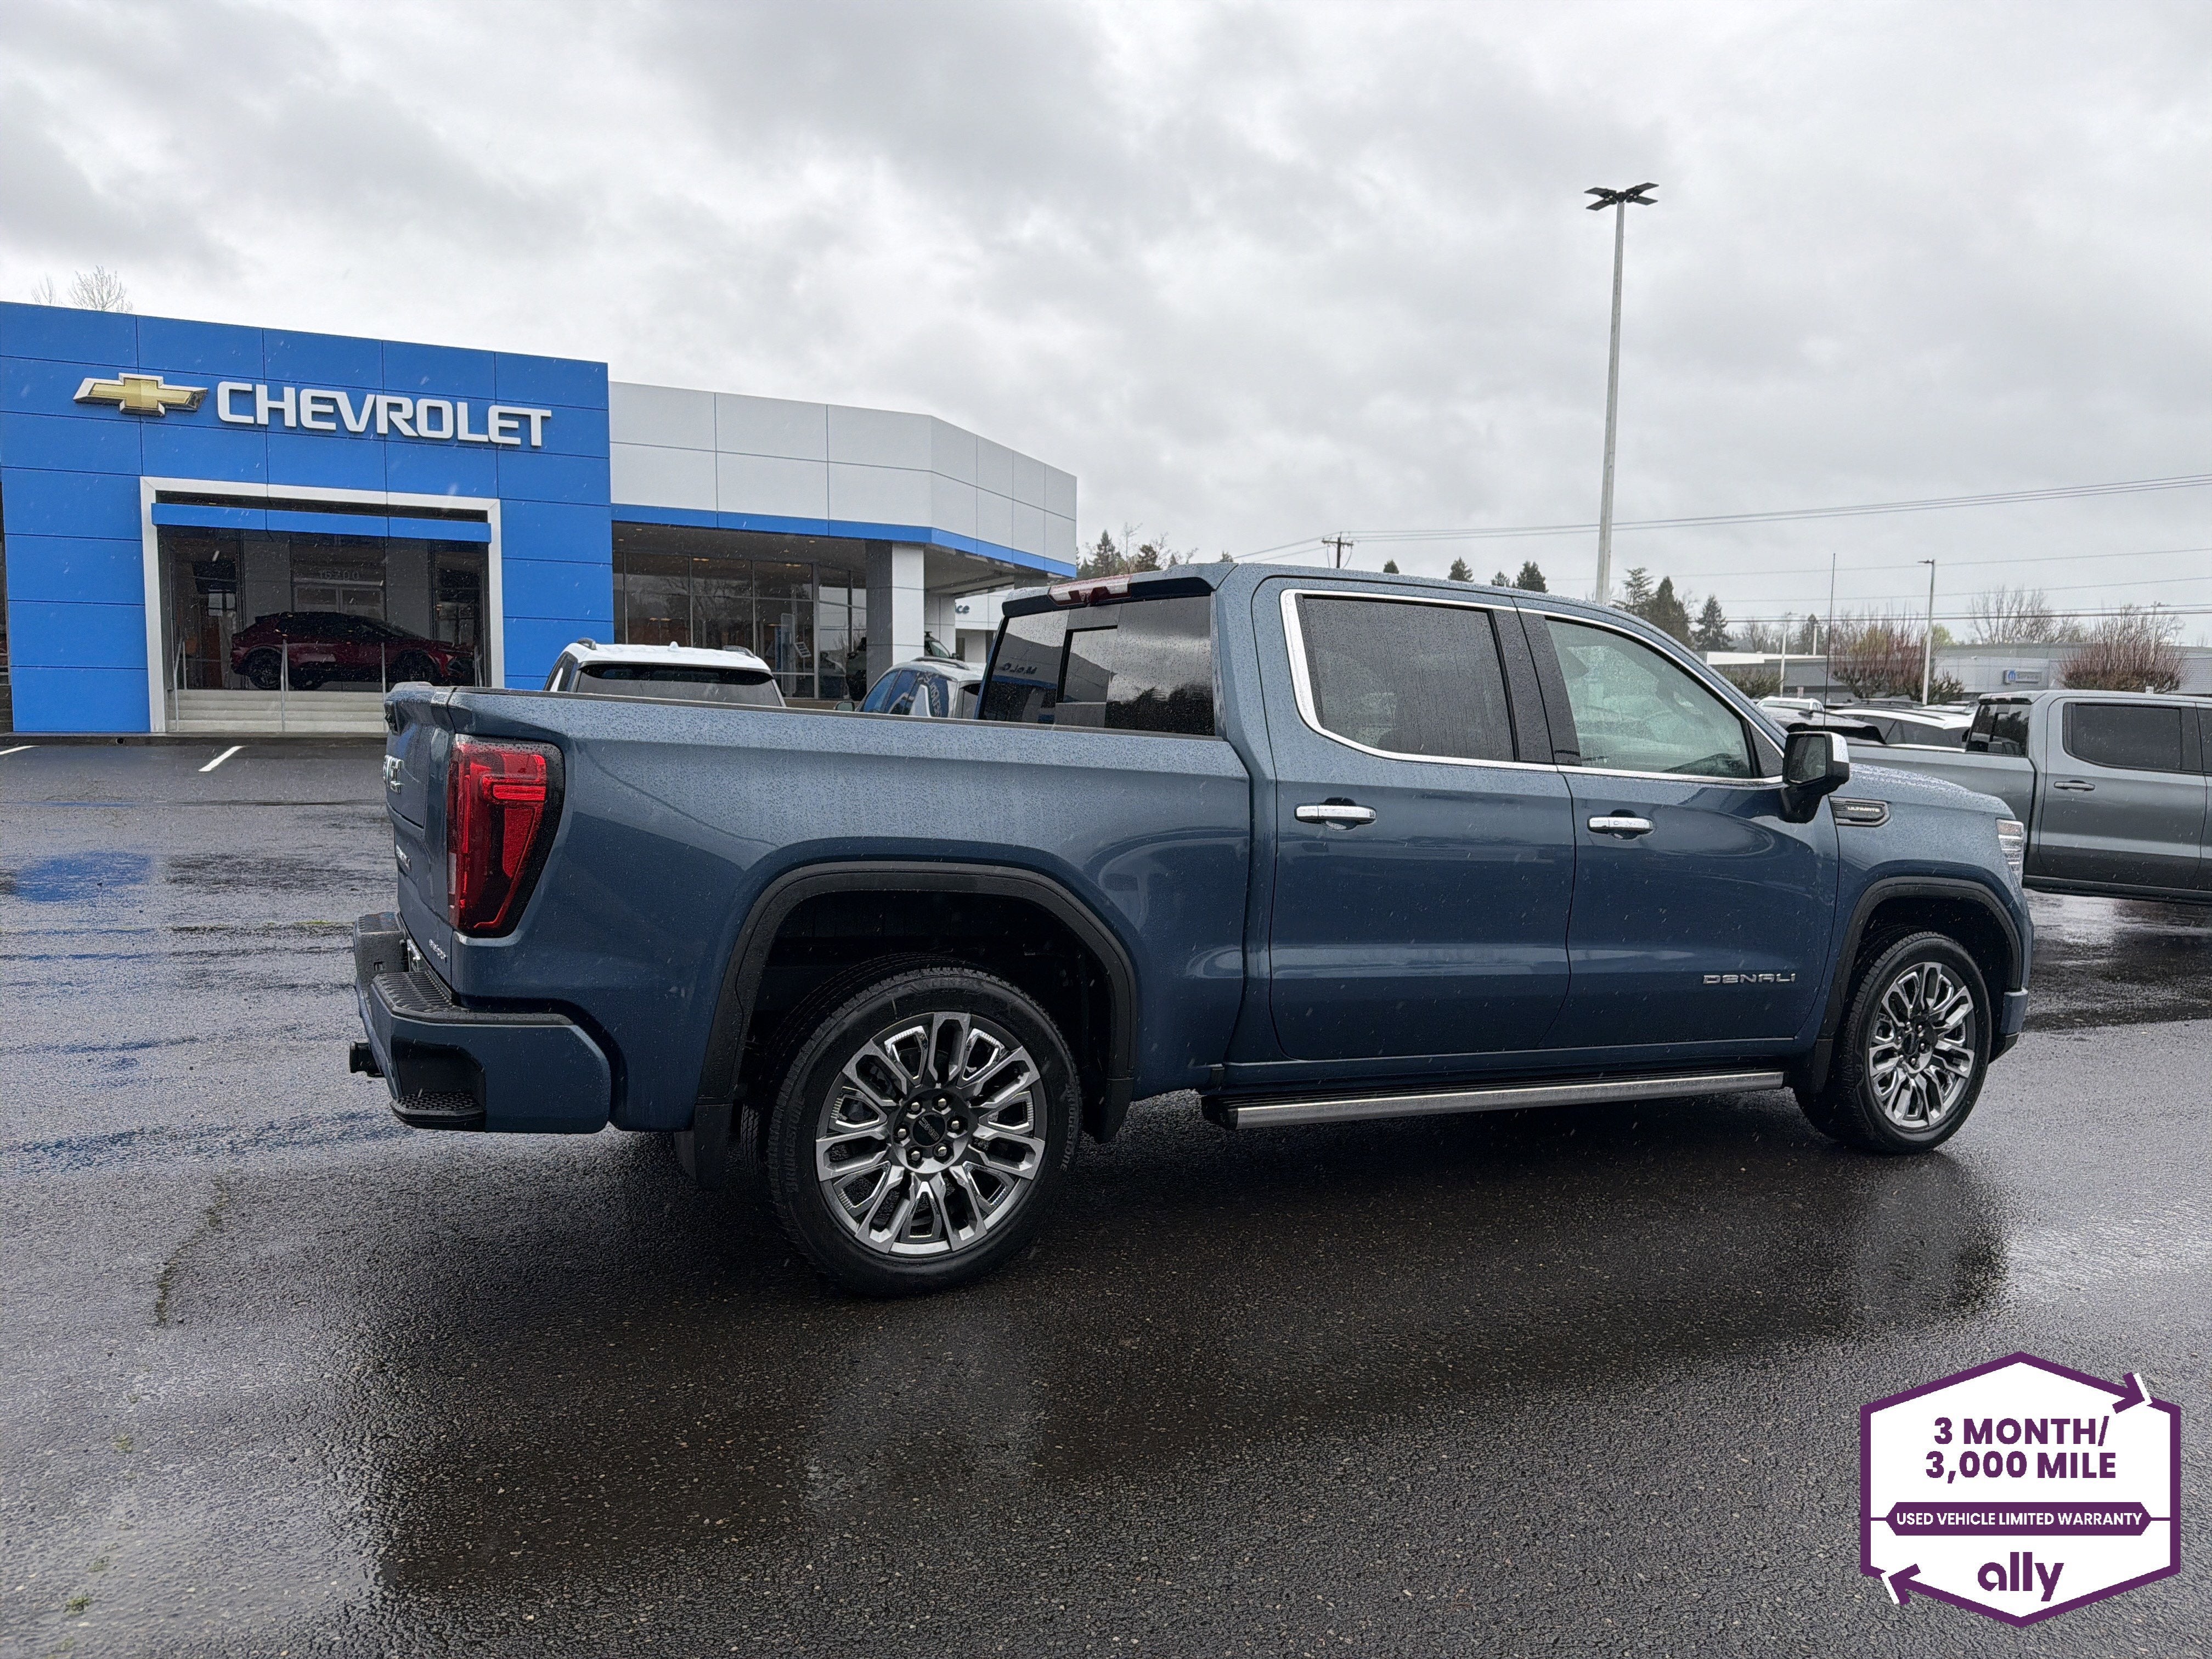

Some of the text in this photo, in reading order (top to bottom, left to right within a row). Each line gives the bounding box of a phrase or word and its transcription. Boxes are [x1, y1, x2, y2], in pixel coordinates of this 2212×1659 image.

[217, 381, 552, 447] CHEVROLET
[1703, 973, 1796, 984] DENALI
[918, 1116, 940, 1141] GMC
